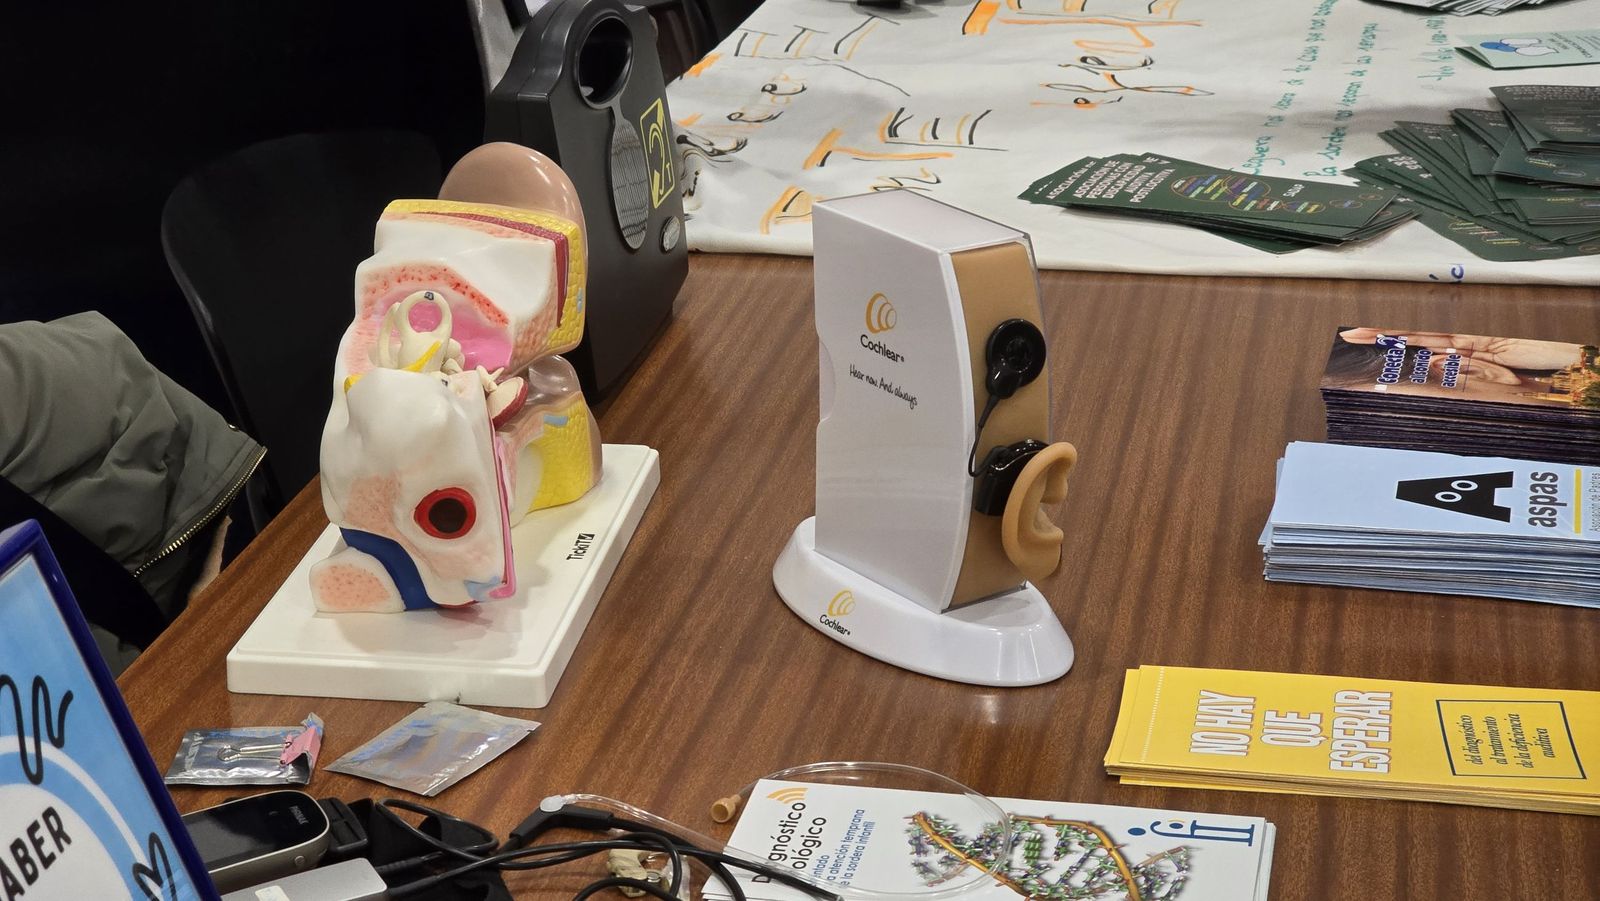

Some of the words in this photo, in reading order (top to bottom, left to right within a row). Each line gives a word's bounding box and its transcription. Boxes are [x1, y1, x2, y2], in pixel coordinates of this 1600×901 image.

[1073, 166, 1111, 199] ASOCIACIÓN
[1086, 172, 1121, 199] PERSONAS
[1102, 165, 1147, 199] DISCAPACIDAD
[849, 363, 865, 381] Hear
[894, 386, 918, 410] always
[1528, 471, 1568, 528] aspas
[1194, 689, 1256, 730] HAY
[1189, 730, 1252, 756] NO
[1260, 709, 1328, 748] QUE
[1329, 689, 1393, 774] ESPERAR
[1456, 714, 1484, 754] diagnóstico
[1482, 715, 1506, 757] tratamiento
[1503, 713, 1533, 752] deficiencia
[1532, 727, 1556, 759] auditiva
[1463, 754, 1484, 765] del
[1489, 757, 1508, 765] al
[751, 802, 807, 884] Dgnóstico
[841, 809, 866, 844] temprana
[855, 820, 876, 845] infantil
[846, 845, 867, 872] sordera
